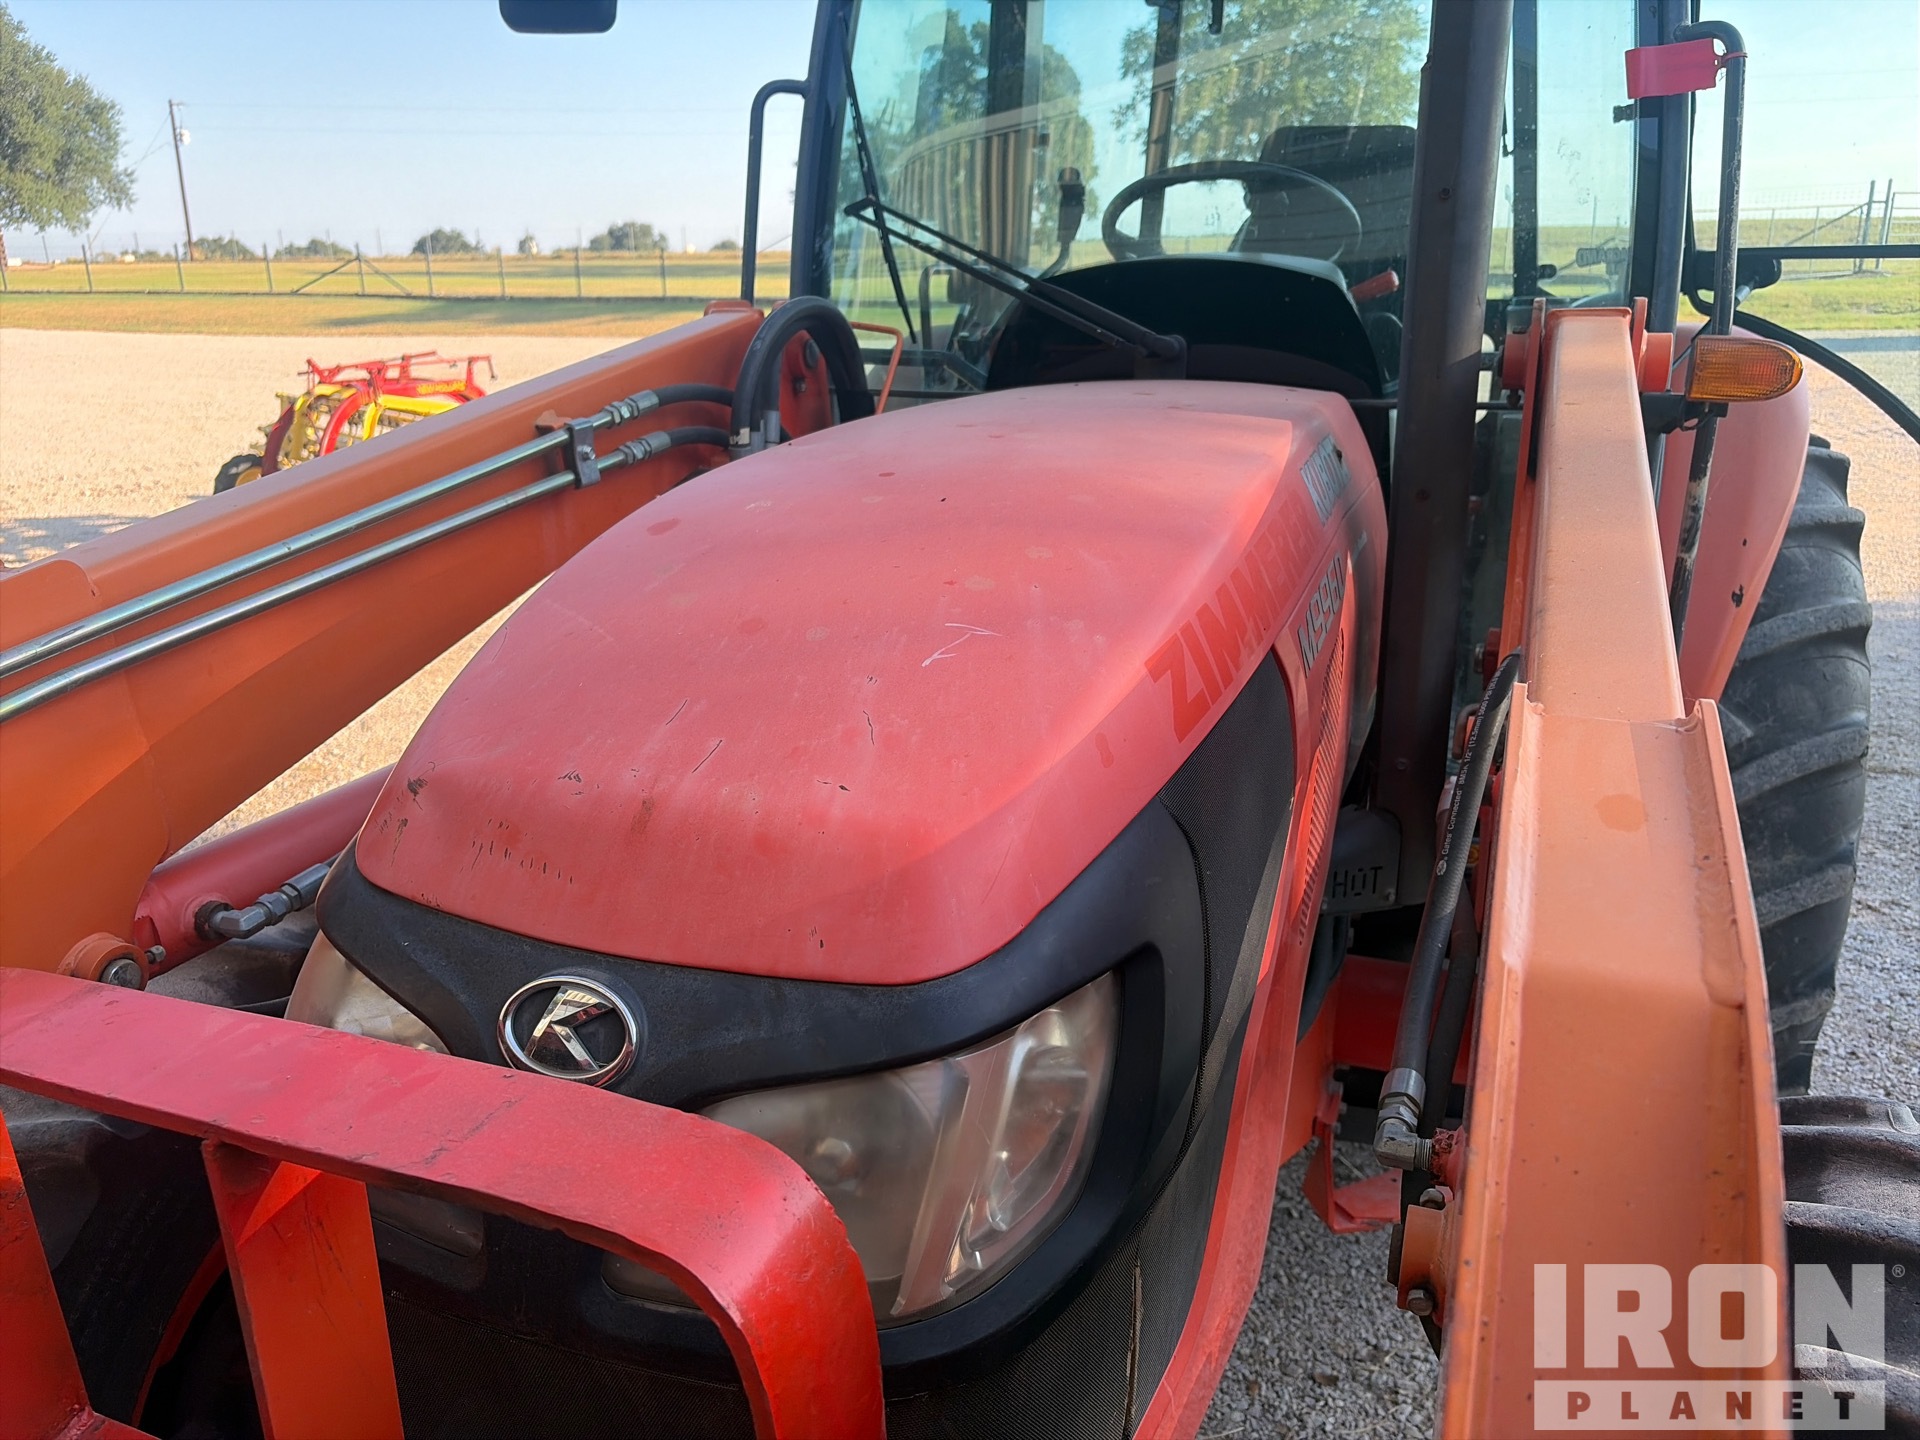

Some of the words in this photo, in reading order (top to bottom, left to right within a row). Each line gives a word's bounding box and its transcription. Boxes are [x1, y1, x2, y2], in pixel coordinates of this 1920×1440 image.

[1297, 551, 1345, 679] M9960
[1447, 789, 1463, 830] Connected
[1332, 866, 1383, 898] HOT
